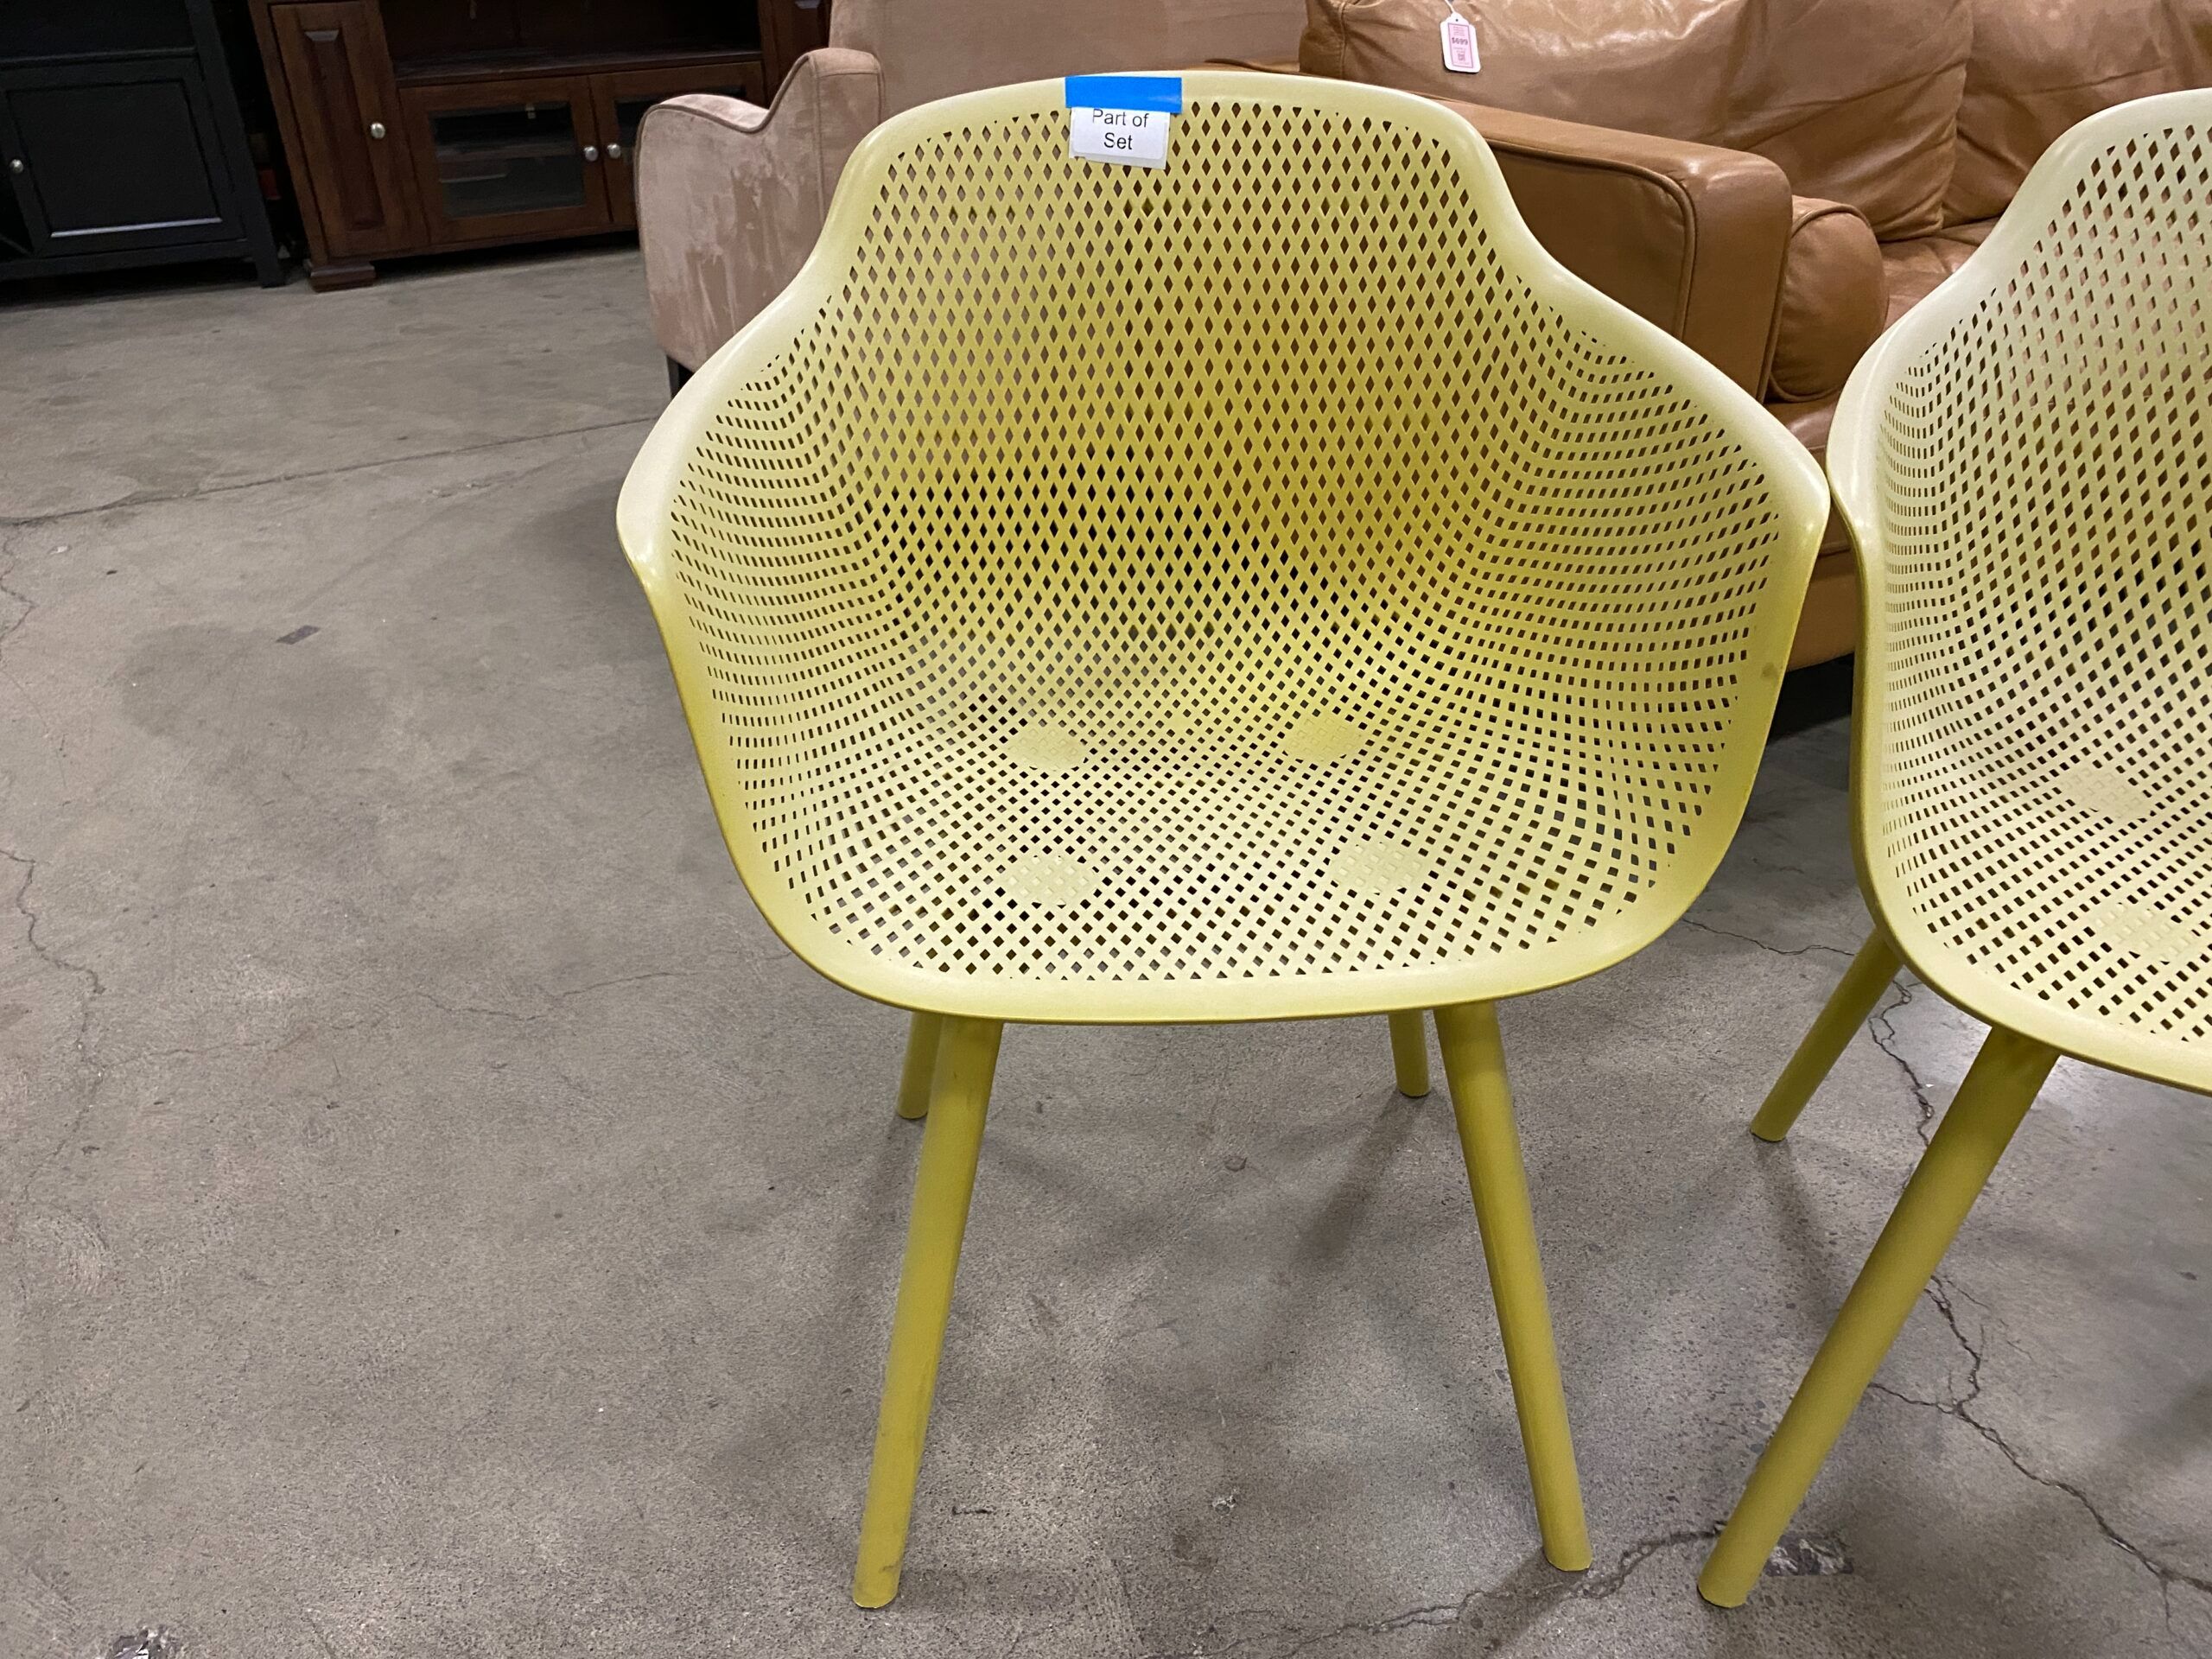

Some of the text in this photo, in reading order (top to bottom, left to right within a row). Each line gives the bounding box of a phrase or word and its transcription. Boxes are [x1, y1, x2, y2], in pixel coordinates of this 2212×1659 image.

[1092, 108, 1149, 128] Part of
[1103, 132, 1133, 150] Set
